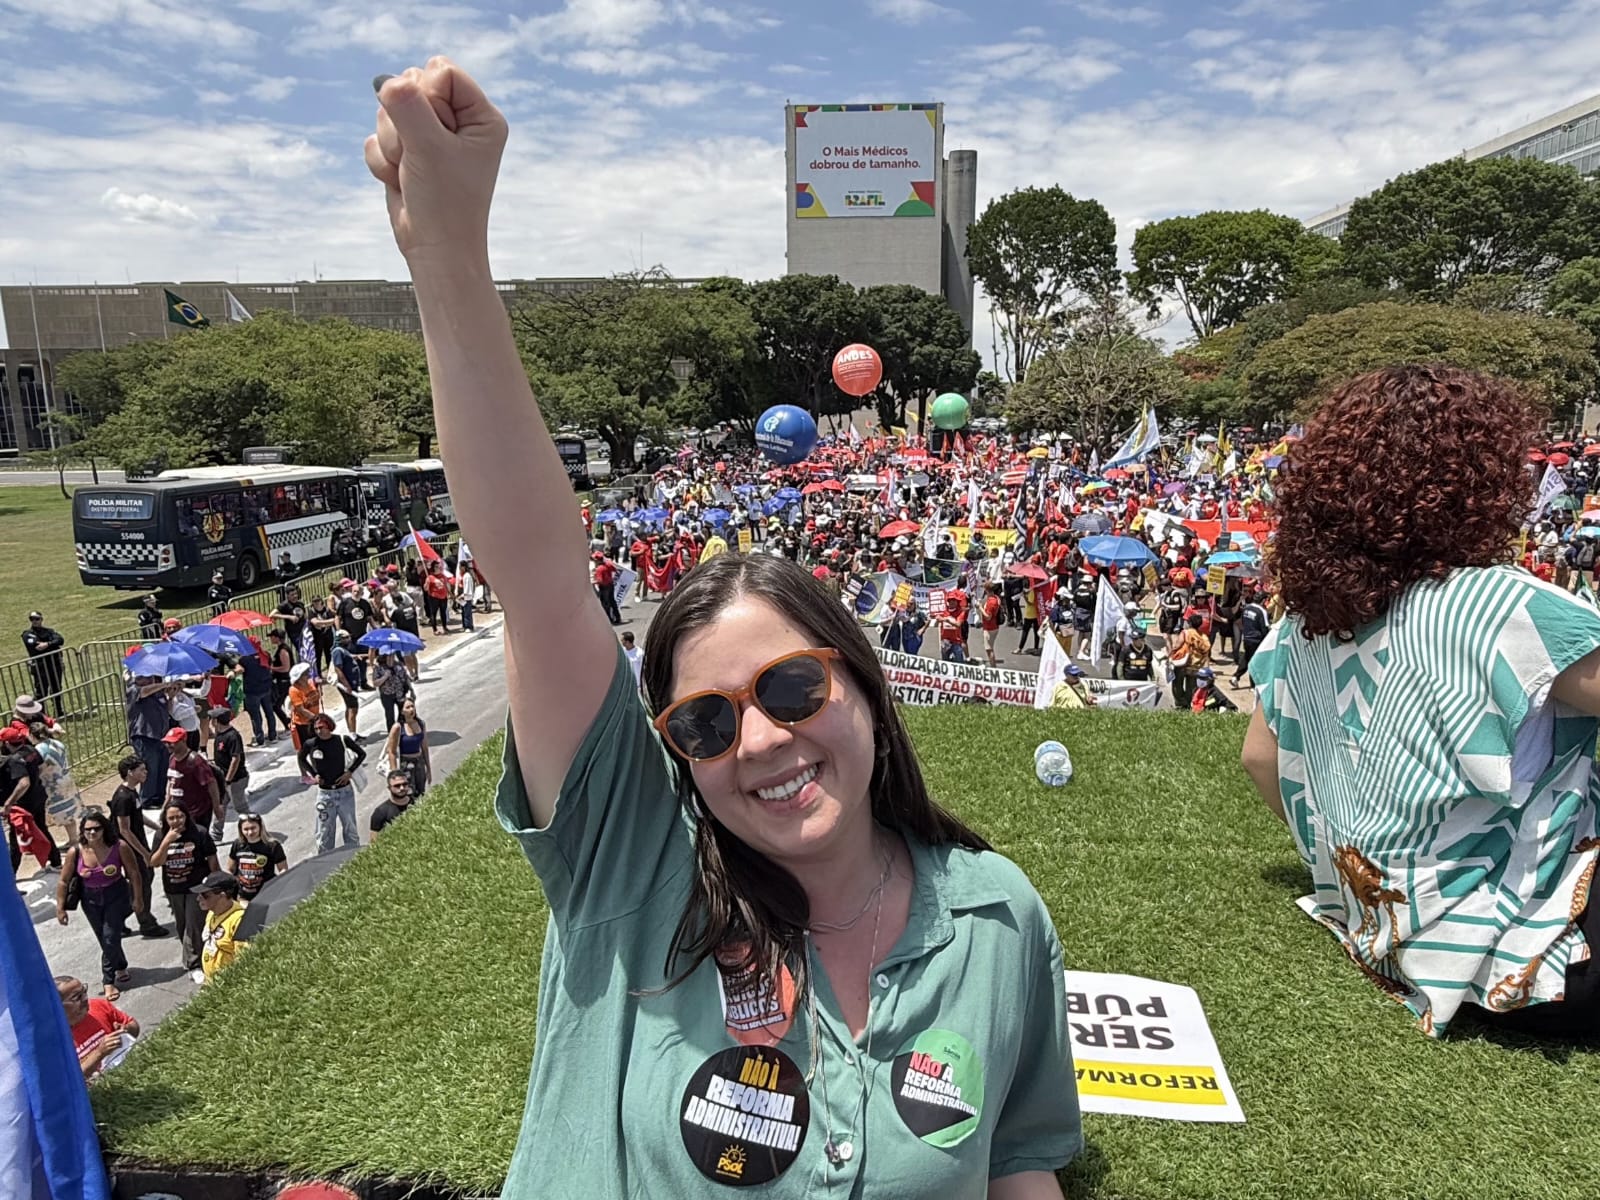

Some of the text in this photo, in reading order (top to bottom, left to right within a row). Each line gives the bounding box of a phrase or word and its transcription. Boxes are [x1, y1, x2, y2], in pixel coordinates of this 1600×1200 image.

[809, 159, 921, 170] dobrou de tamanho.
[822, 146, 908, 157] O Mais Médicos
[837, 350, 873, 365] ANDES
[88, 498, 114, 506] POLÍCIA
[875, 648, 948, 676] ALORIZAÇÃO
[1003, 671, 1016, 686] SE
[973, 683, 993, 698] DO
[739, 1054, 780, 1090] NÃO À
[909, 1051, 942, 1077] NÃO
[942, 1062, 953, 1083] À
[705, 1074, 795, 1122] REFORMA
[904, 1068, 961, 1099] REFORMA
[900, 1084, 978, 1117] ADMINISTRATIVA!
[683, 1095, 802, 1152] ADMINISTRATIVA!
[717, 1157, 743, 1174] PSOL
